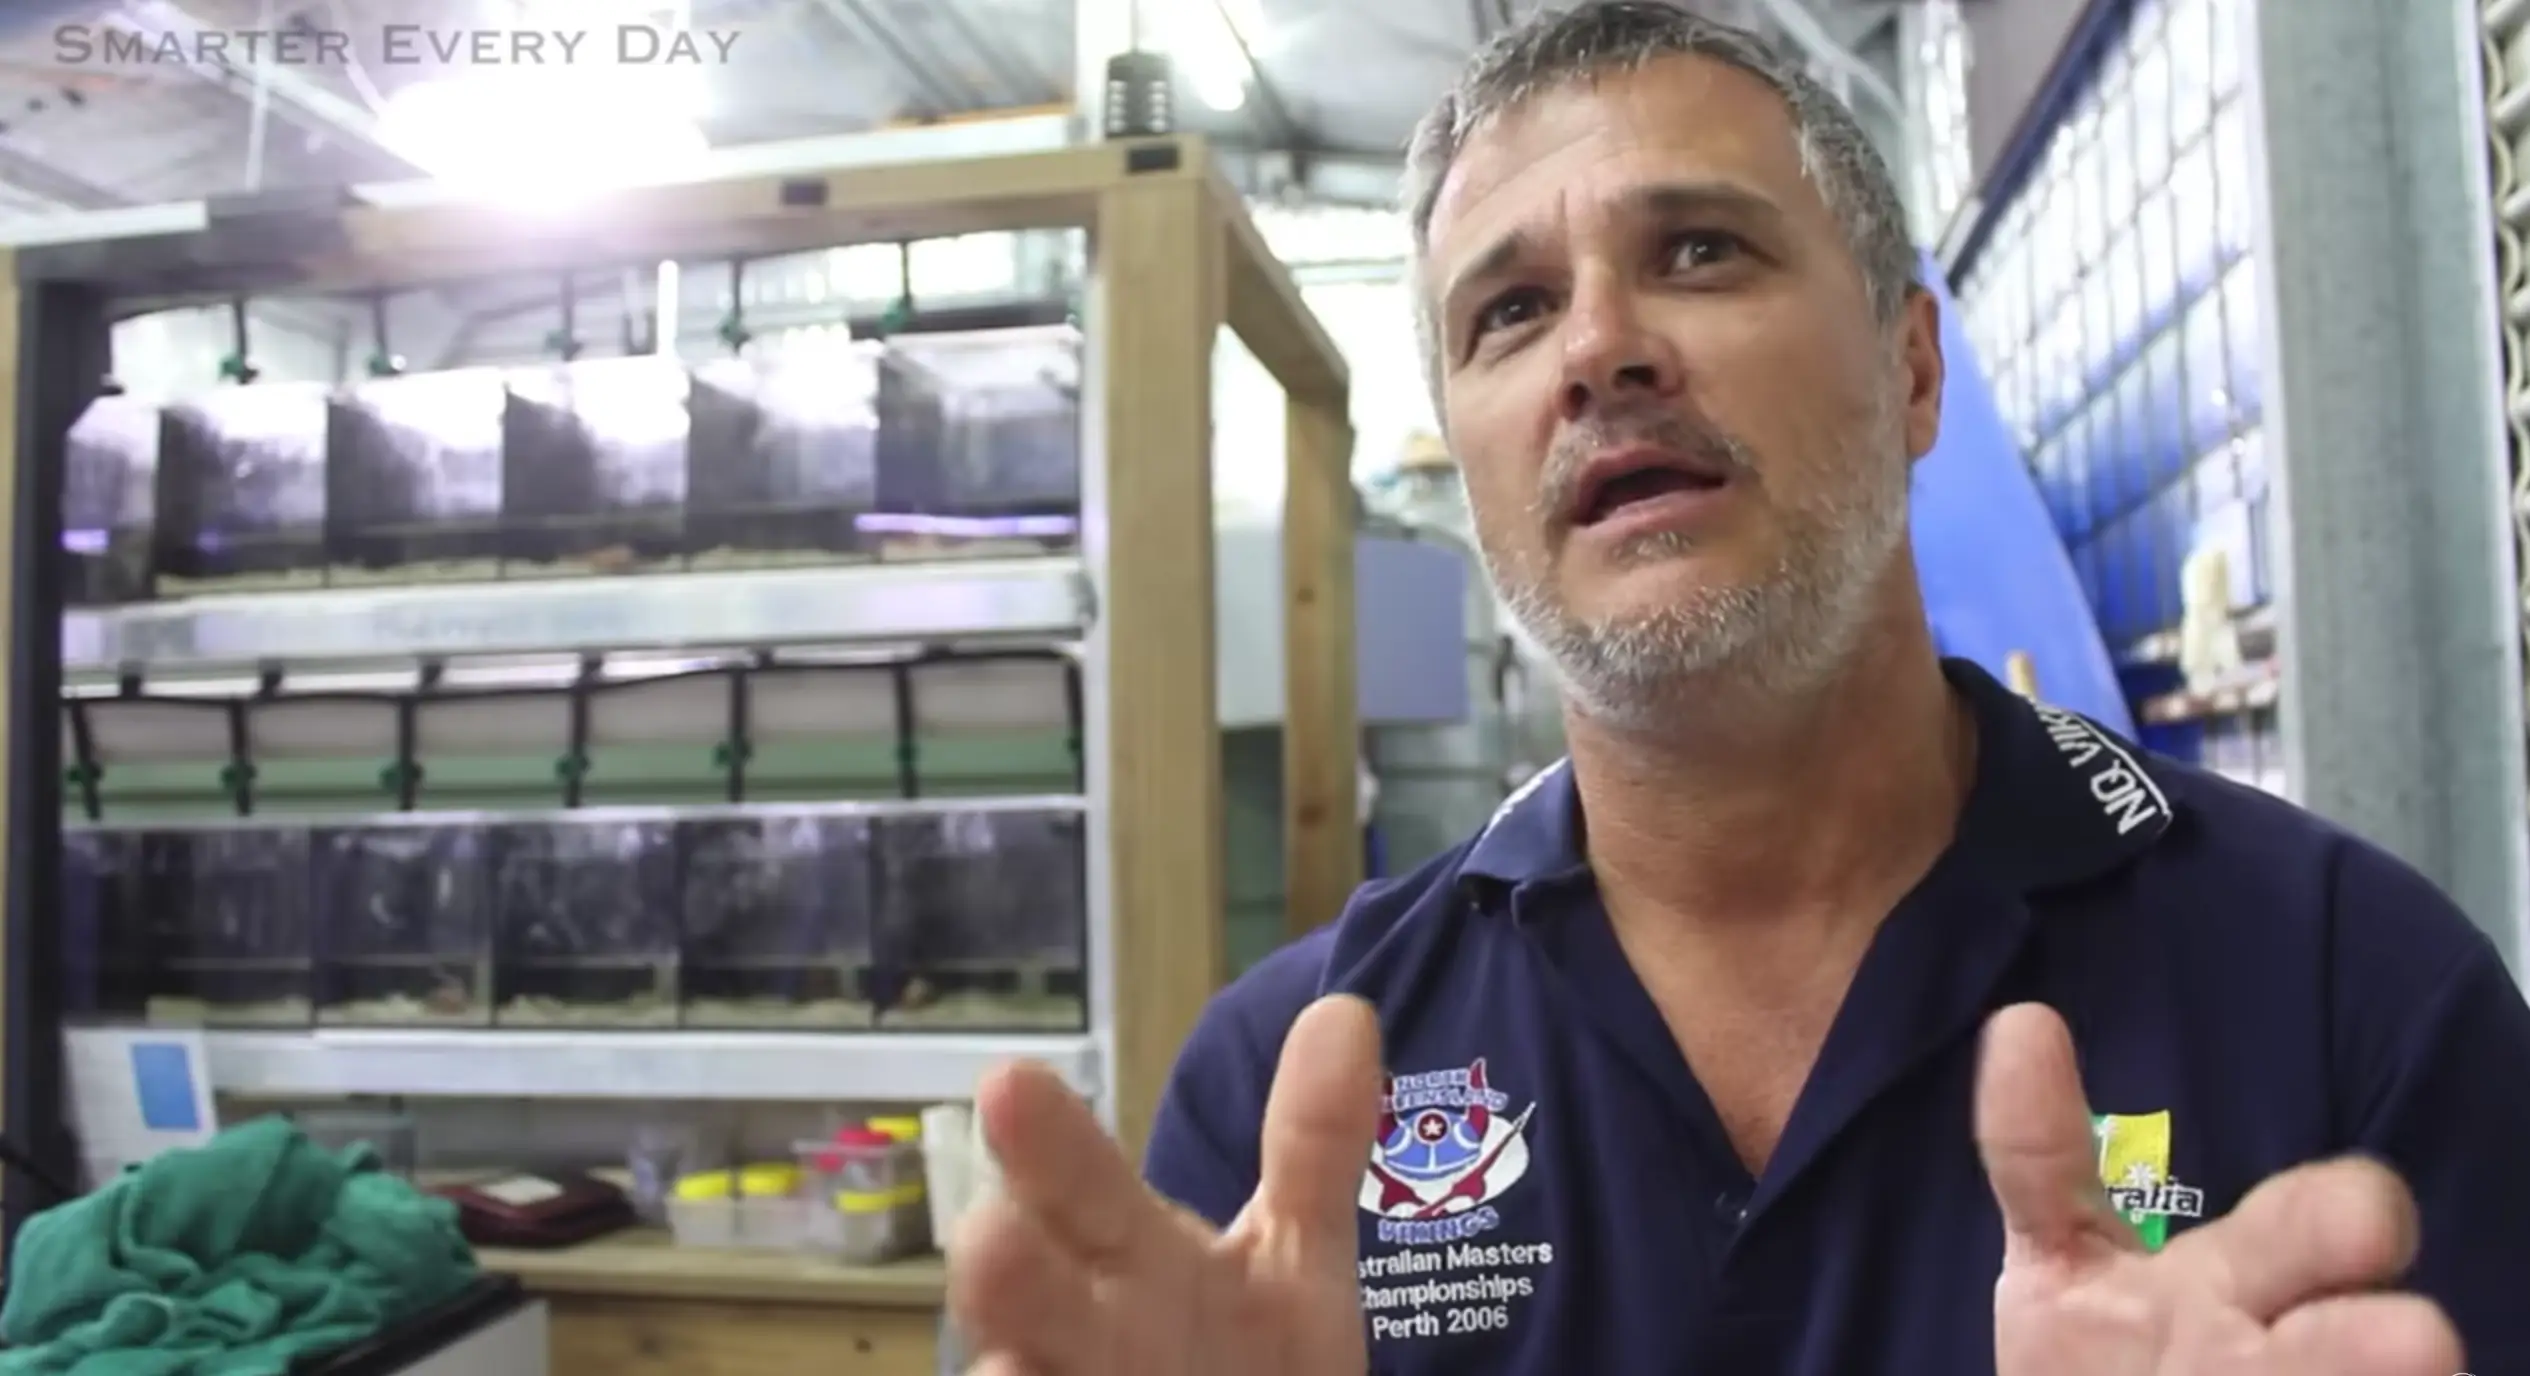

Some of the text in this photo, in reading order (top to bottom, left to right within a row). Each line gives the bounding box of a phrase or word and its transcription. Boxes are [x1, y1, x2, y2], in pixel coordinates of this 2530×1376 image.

[2090, 760, 2157, 834] NQ
[2104, 1176, 2204, 1218] ralia
[1378, 1207, 1499, 1243] VIKINGS
[1359, 1243, 1553, 1278] stralian Masters
[1361, 1274, 1533, 1309] hampionships
[1372, 1306, 1509, 1340] Perth 2006
